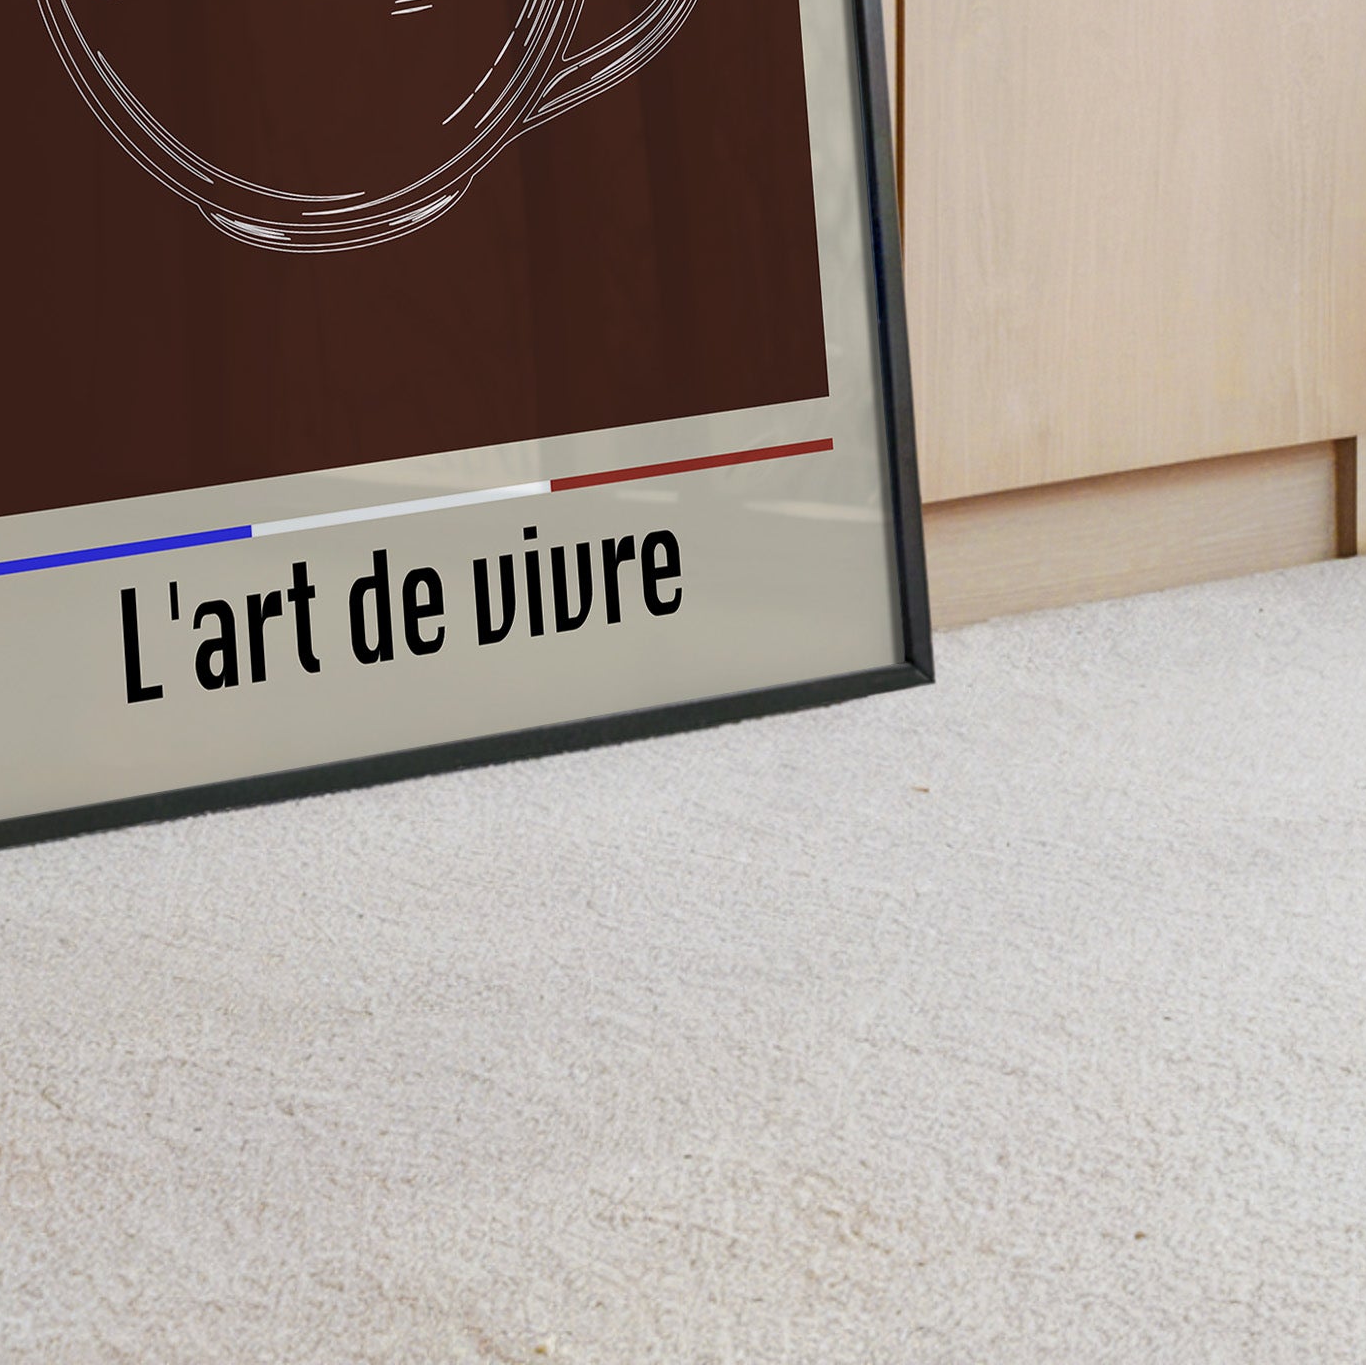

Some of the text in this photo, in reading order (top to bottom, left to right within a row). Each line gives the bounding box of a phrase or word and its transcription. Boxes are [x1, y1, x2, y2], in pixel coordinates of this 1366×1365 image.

[119, 525, 684, 704] L'art de vivre
